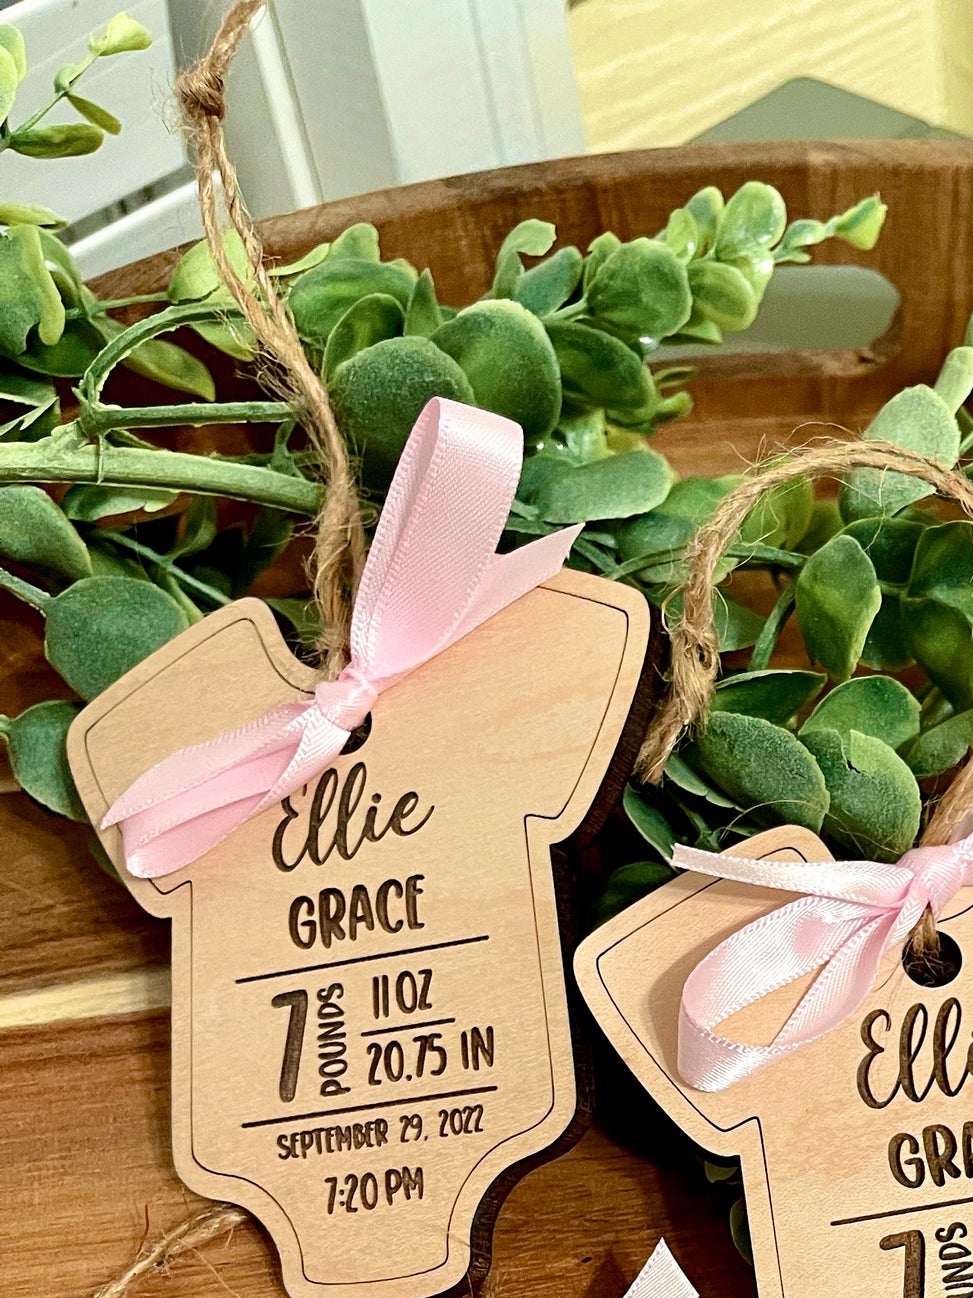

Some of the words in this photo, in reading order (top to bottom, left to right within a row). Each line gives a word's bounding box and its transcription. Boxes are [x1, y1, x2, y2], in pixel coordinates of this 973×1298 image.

[288, 874, 426, 950] GRACE
[270, 989, 309, 1103] 7
[317, 982, 351, 1097] POUNDS
[367, 1033, 448, 1086] 20.75
[460, 1026, 494, 1072] IN
[277, 1118, 388, 1160] SEPTEMBER
[438, 1104, 484, 1138] 2022
[325, 1174, 378, 1215] 7:20
[385, 1166, 424, 1204] PM
